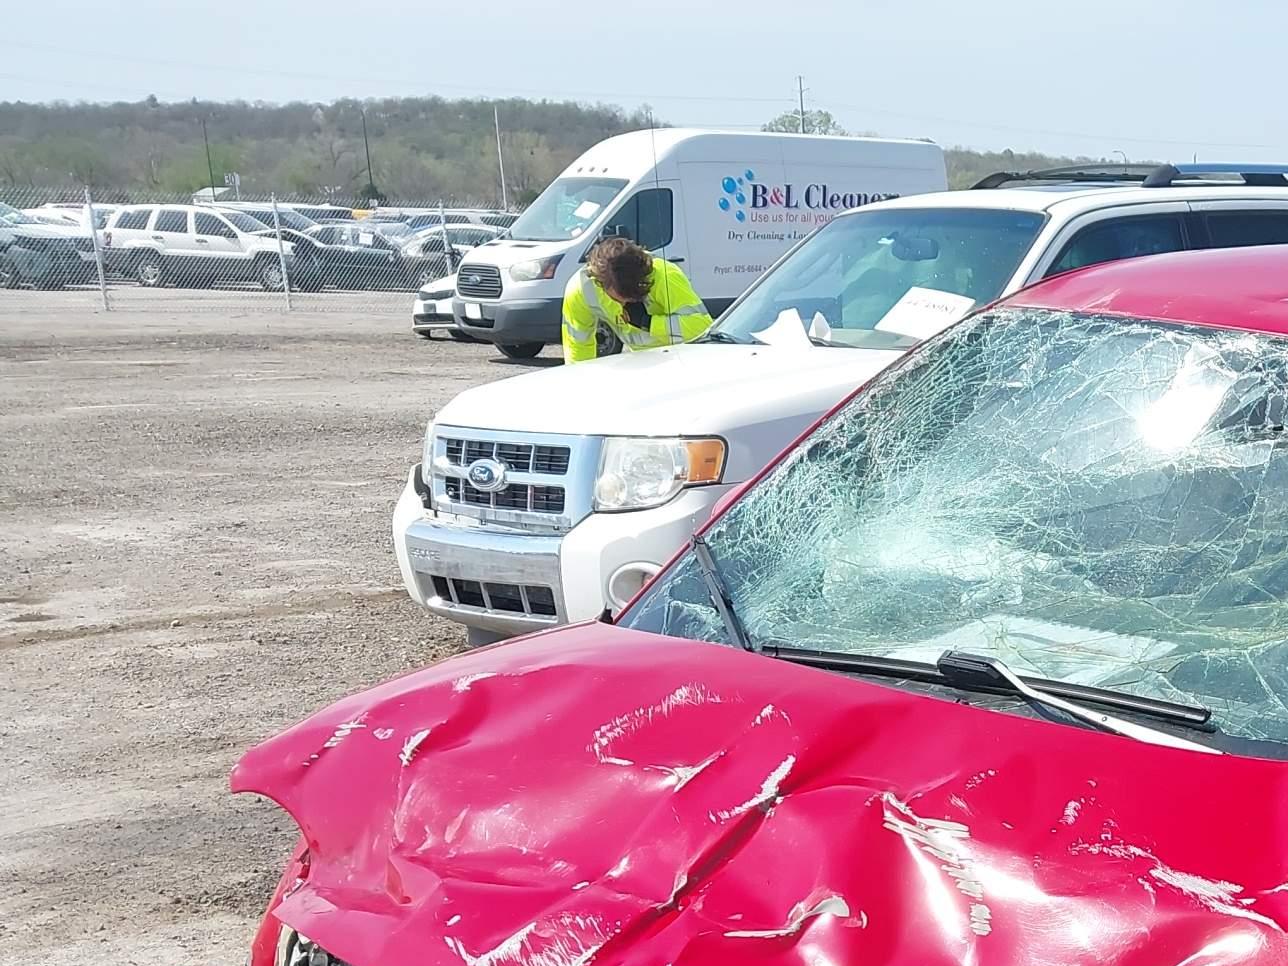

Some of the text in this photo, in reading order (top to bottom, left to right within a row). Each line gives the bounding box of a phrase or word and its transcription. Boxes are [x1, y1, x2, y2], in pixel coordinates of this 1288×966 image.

[750, 183, 799, 209] B&L
[751, 212, 769, 223] Use
[772, 214, 783, 223] us
[786, 212, 799, 223] for
[801, 212, 812, 223] all
[728, 231, 744, 243] Dry
[747, 231, 785, 241] Cleaning
